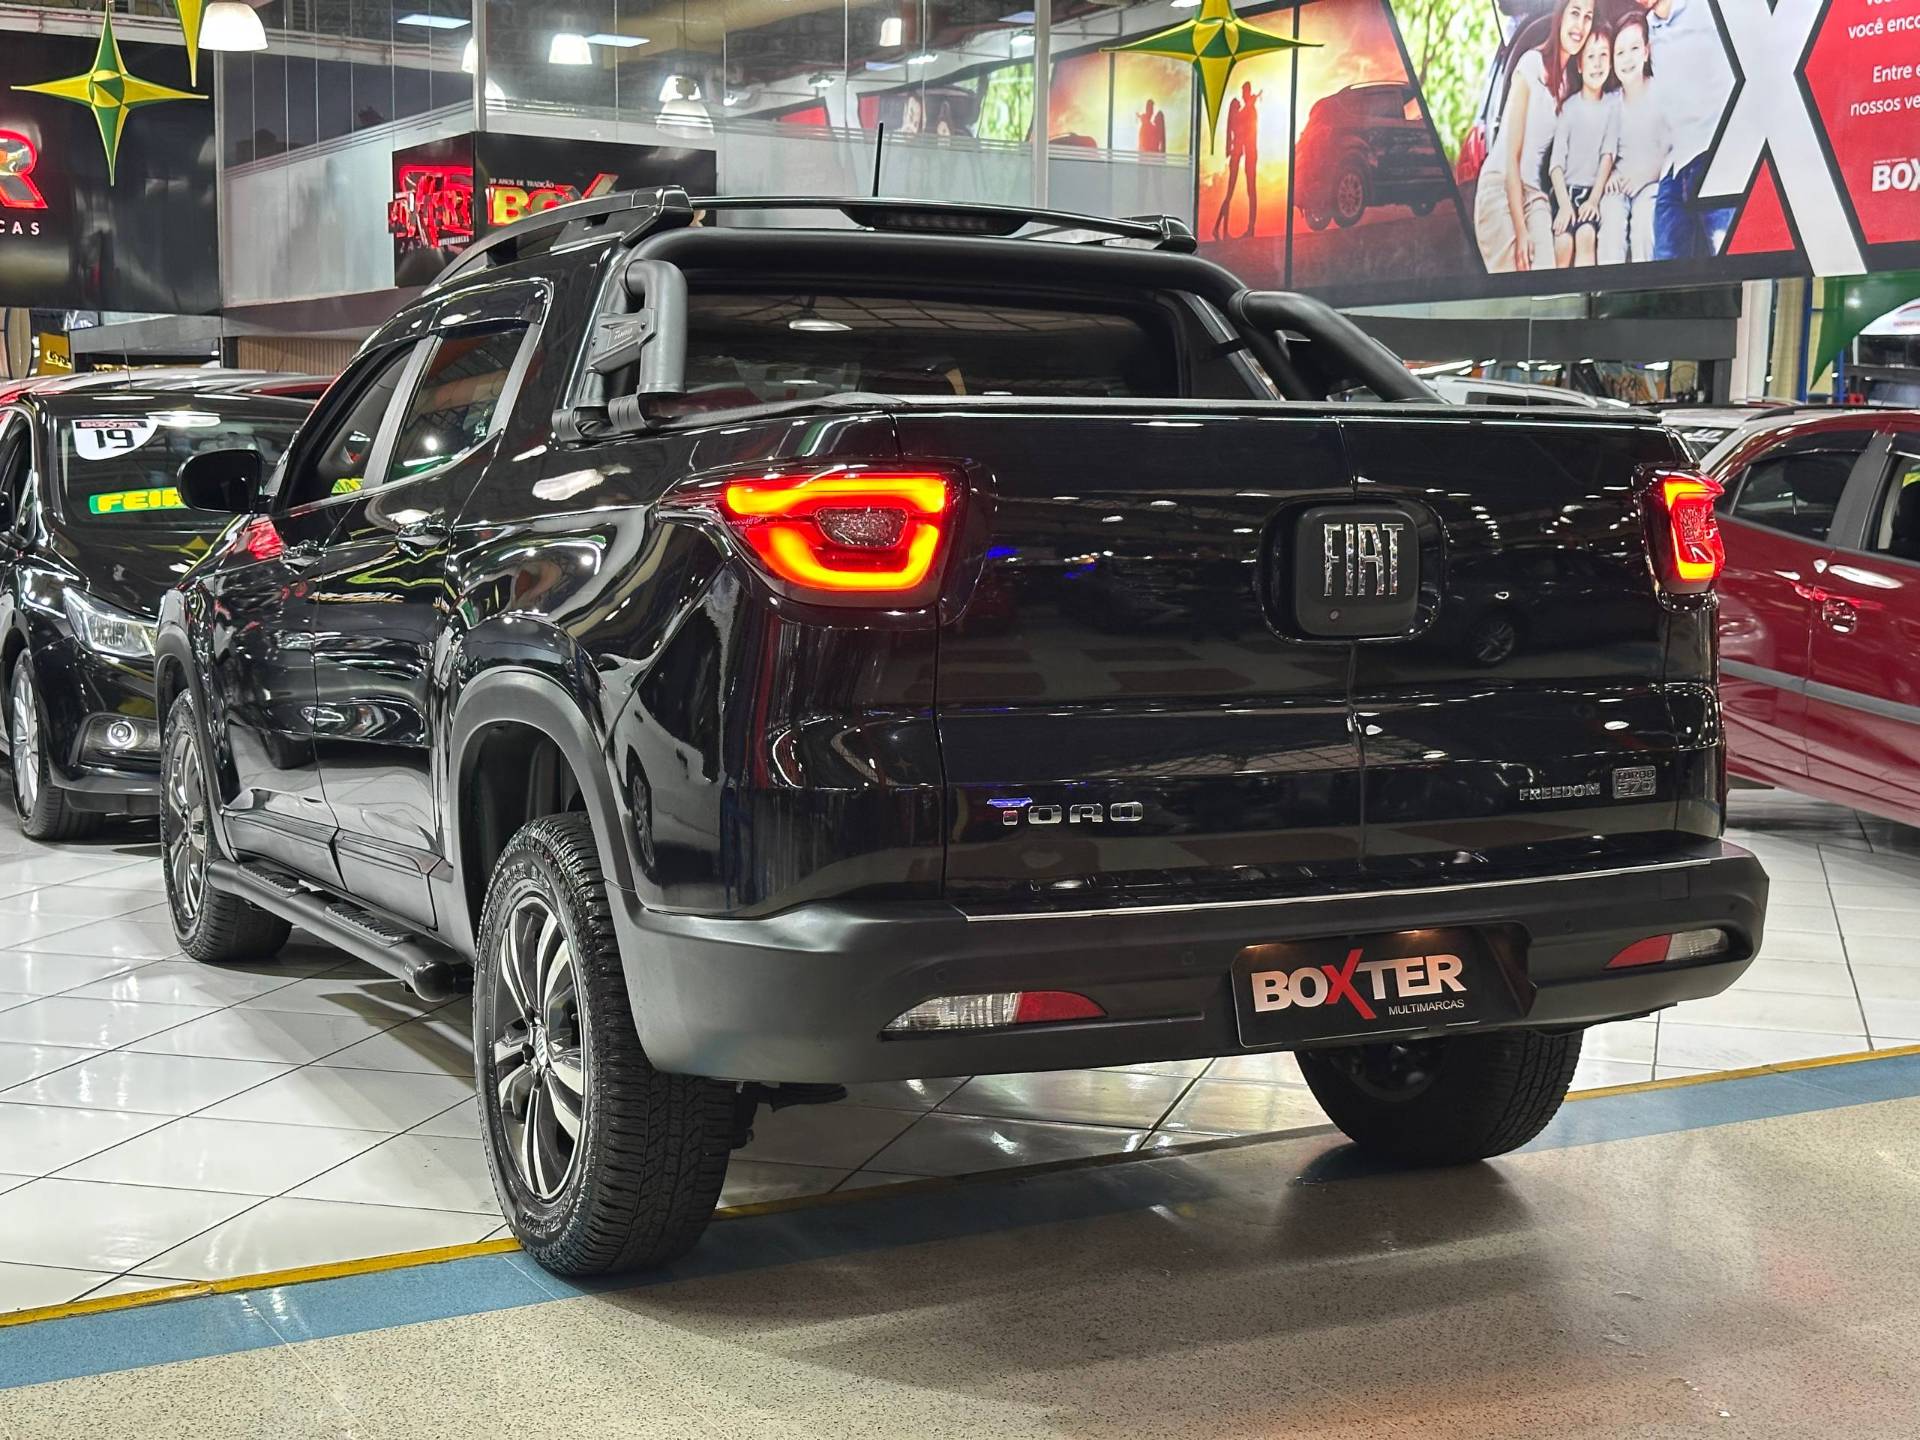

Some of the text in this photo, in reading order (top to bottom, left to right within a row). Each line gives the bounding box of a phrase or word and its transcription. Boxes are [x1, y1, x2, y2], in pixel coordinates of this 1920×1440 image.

[1848, 17, 1884, 39] você
[1873, 64, 1912, 83] Entre
[1850, 97, 1901, 117] nossos
[95, 429, 135, 449] 19
[1323, 523, 1404, 597] FIAT
[1519, 783, 1601, 801] FREEDOM
[987, 797, 1144, 826] TORO
[1251, 949, 1468, 1020] BOXTER
[1388, 999, 1466, 1016] MULTIMARCAS
